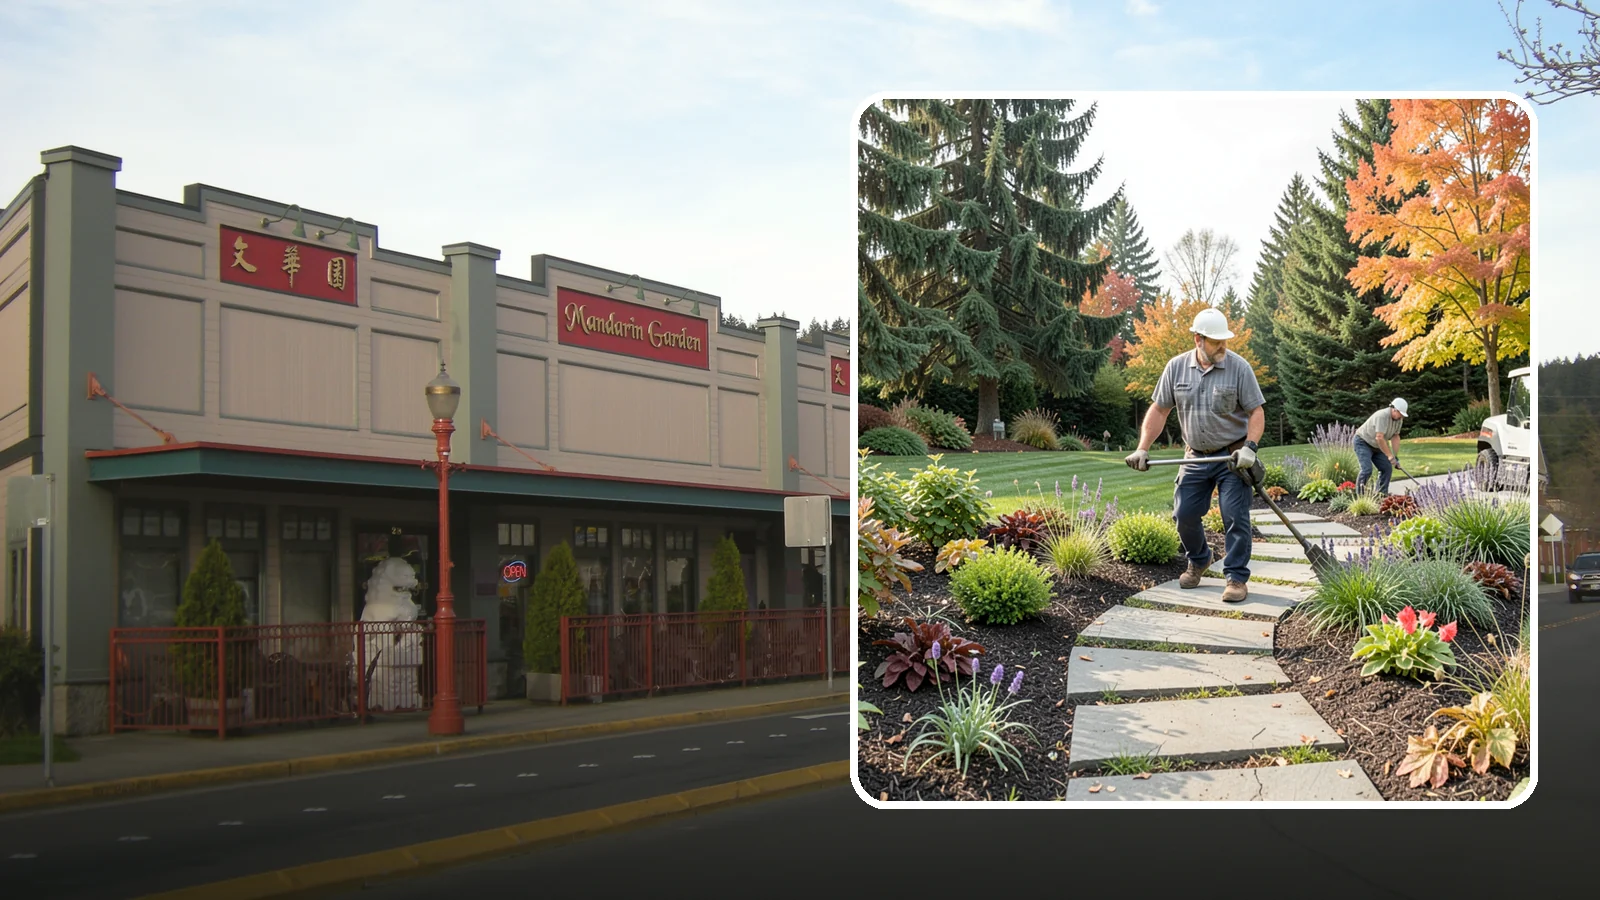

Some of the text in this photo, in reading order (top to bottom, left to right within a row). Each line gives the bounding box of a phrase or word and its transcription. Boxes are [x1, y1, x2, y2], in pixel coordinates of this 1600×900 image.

[564, 302, 702, 352] Mandarin Garden
[503, 565, 527, 578] OPEN
